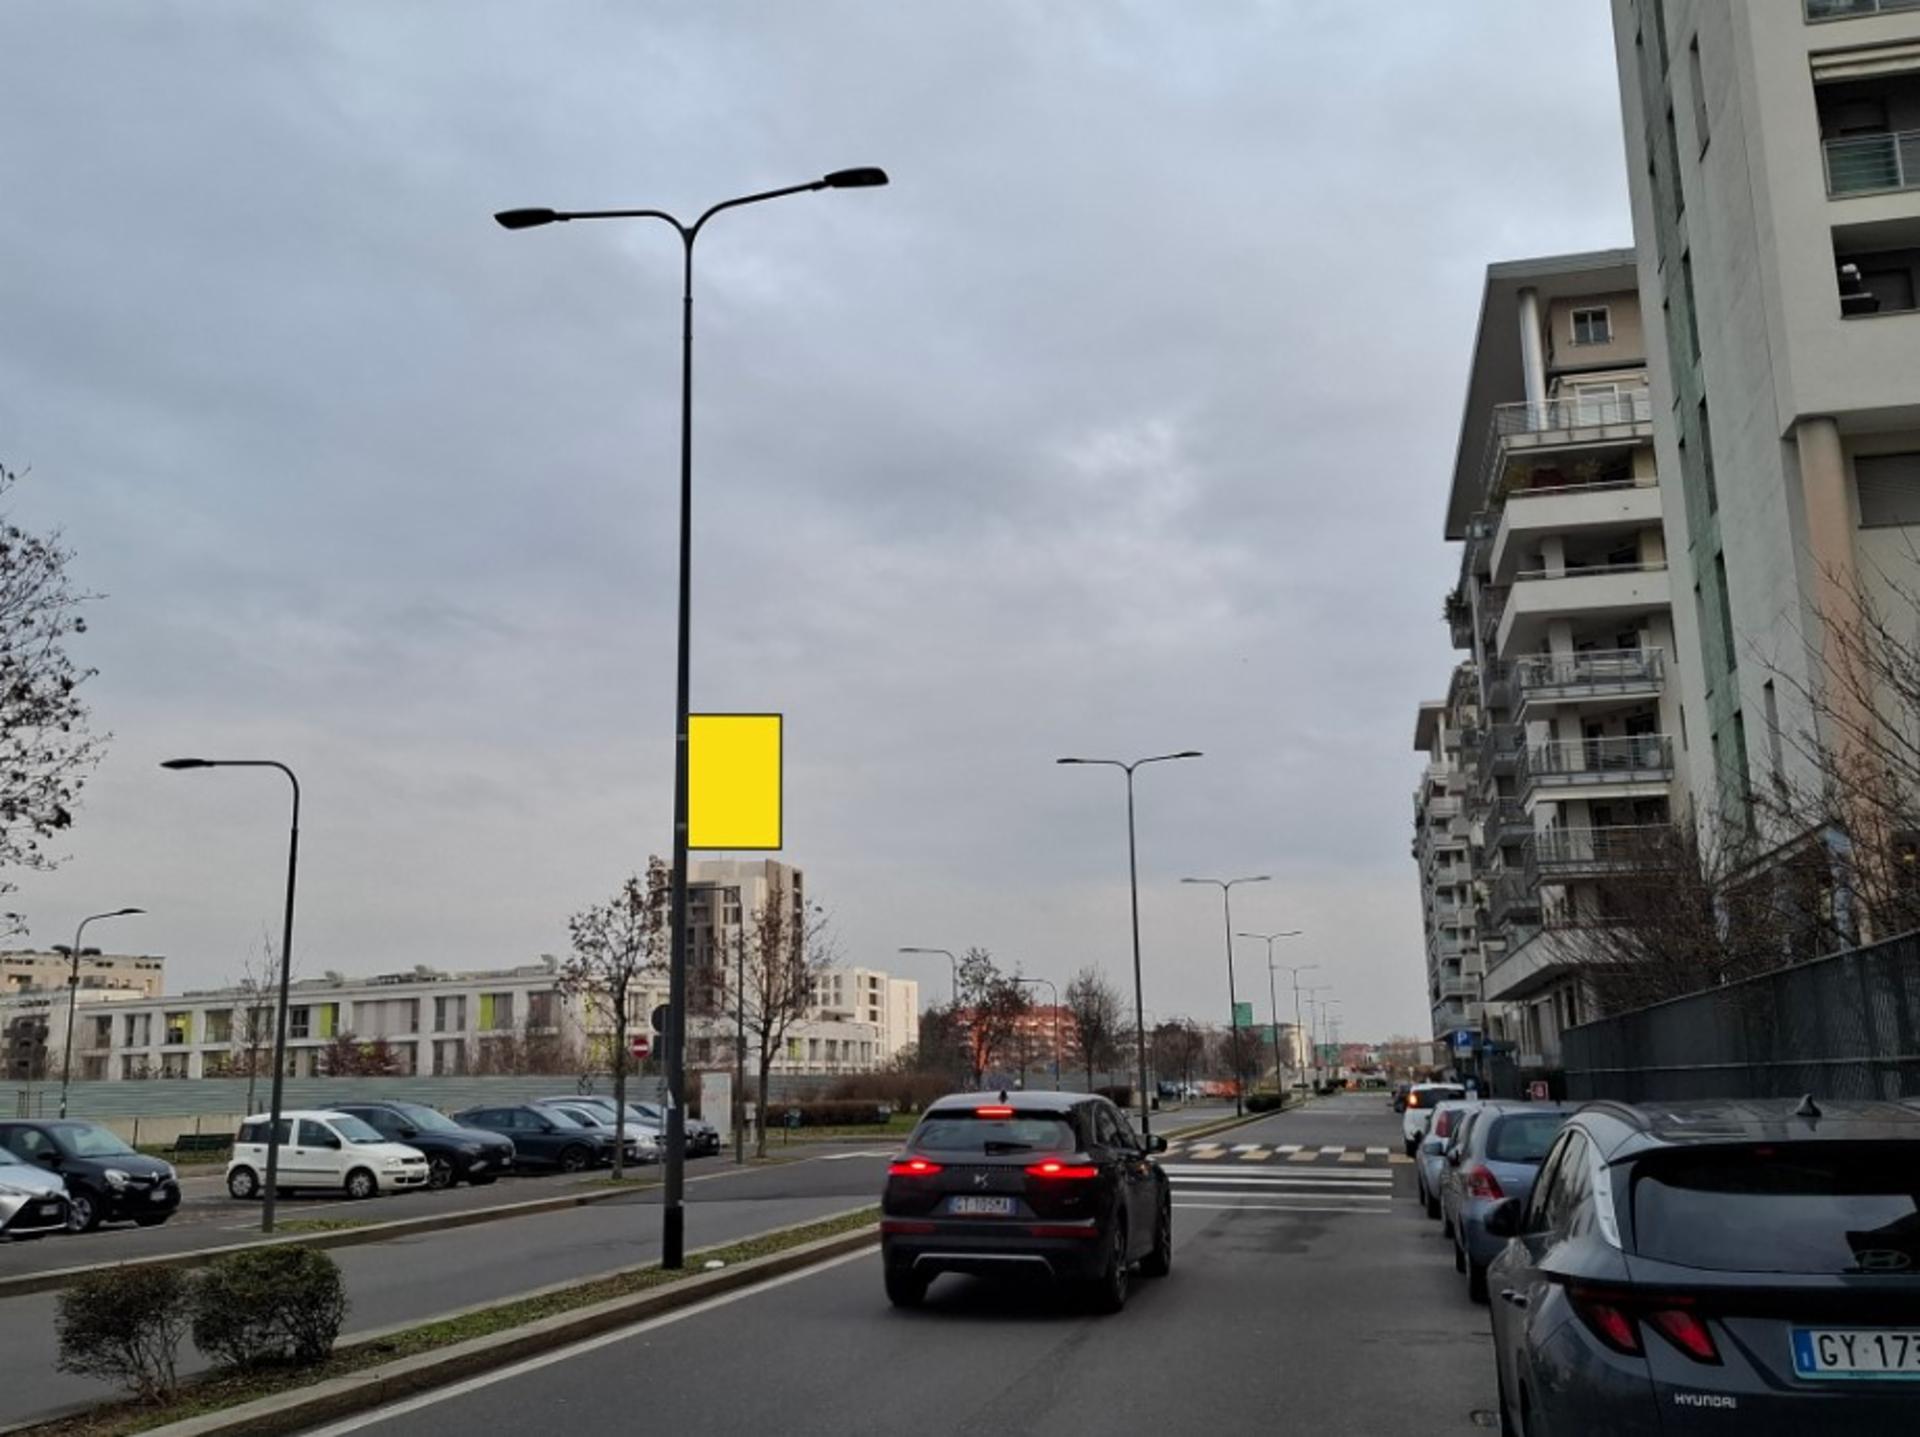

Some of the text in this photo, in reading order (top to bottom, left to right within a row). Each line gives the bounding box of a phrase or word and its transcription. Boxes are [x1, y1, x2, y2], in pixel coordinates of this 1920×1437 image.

[1457, 1031, 1467, 1044] P
[1818, 1334, 1856, 1367] GY
[1674, 1392, 1737, 1408] HYUNDAI
